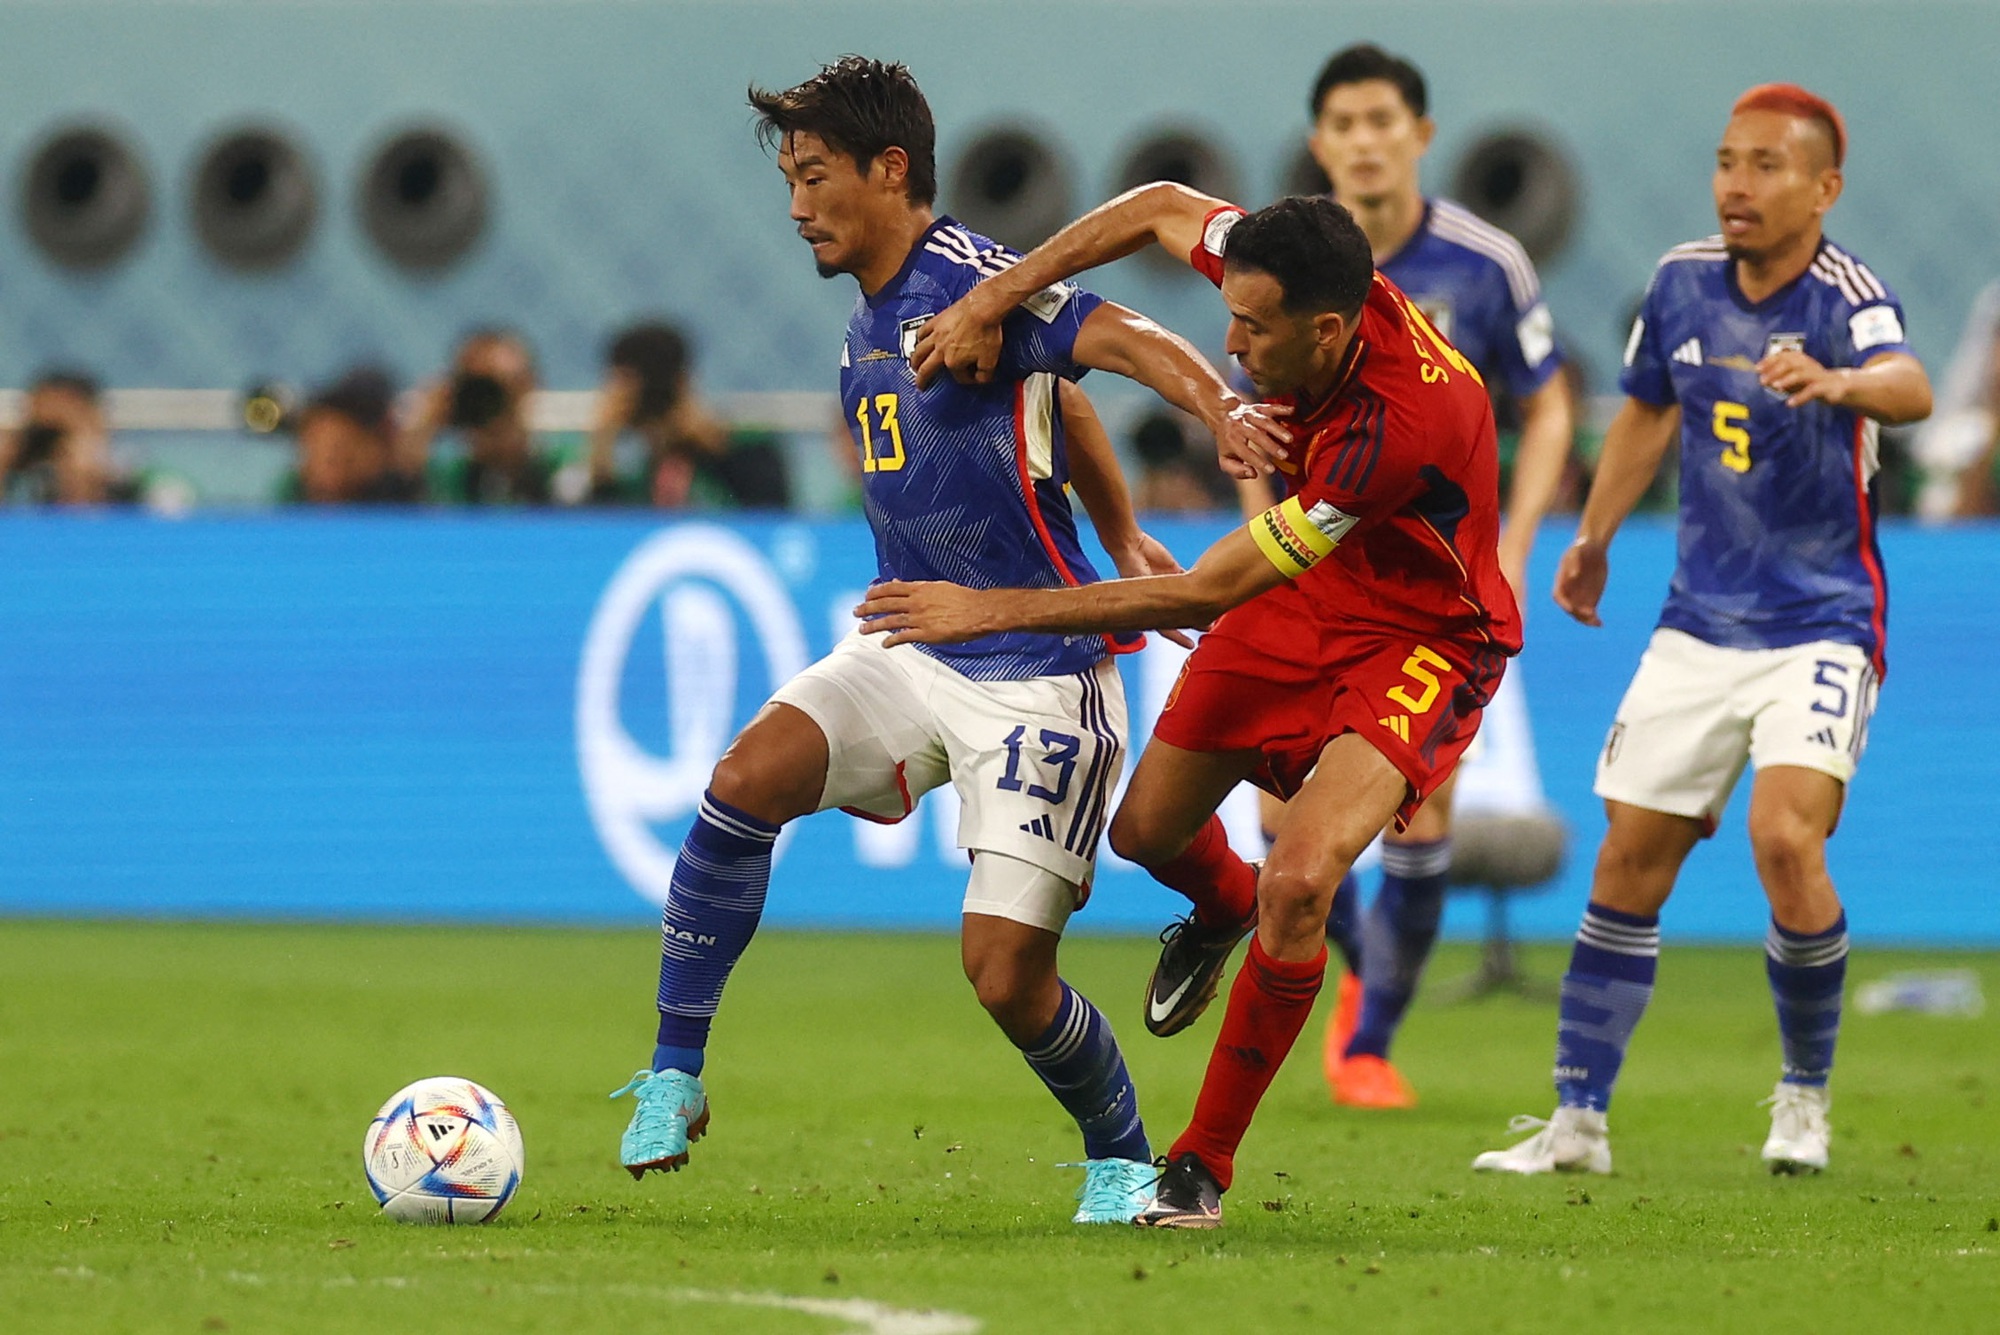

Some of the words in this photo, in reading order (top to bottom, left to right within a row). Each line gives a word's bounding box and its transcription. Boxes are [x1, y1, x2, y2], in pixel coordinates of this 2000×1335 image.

[856, 394, 905, 472] 13
[1712, 401, 1751, 473] 5
[1272, 505, 1320, 561] PROTECT
[1386, 644, 1452, 714] 5
[1810, 659, 1849, 719] 5
[996, 725, 1080, 804] 13
